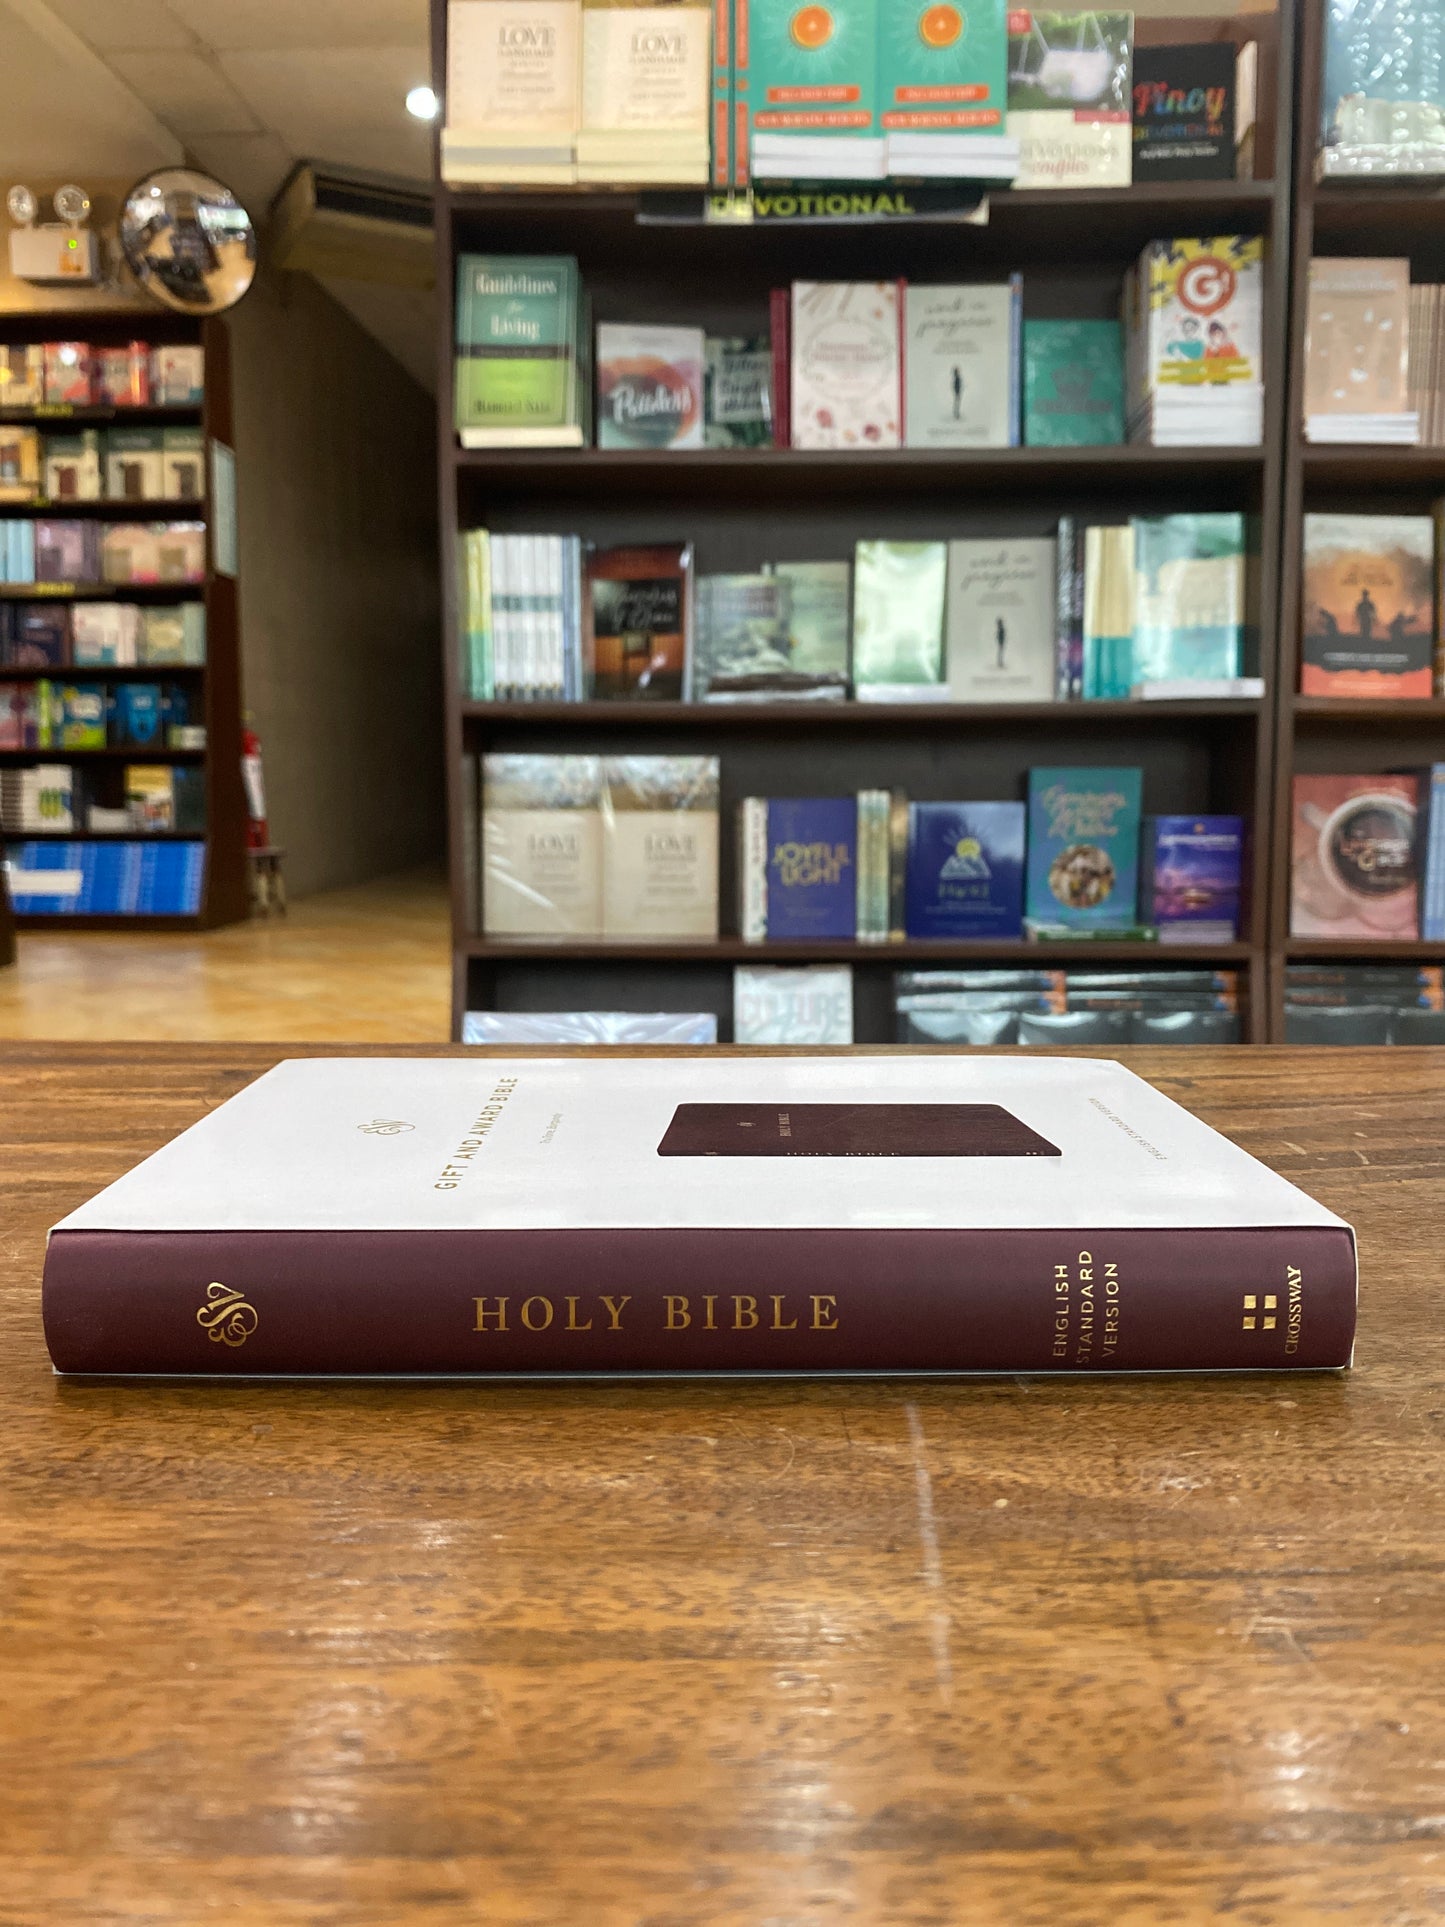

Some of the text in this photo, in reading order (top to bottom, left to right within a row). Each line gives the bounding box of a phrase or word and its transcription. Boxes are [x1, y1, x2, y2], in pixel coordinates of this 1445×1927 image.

[499, 27, 555, 47] LOVE
[630, 34, 687, 54] LOVE
[491, 315, 541, 341] Living
[434, 1077, 518, 1190] GIFT AND AWARD BIBLE
[471, 1294, 839, 1331] HOLY BIBLE
[1052, 1264, 1069, 1357] ENGLISH
[1075, 1250, 1094, 1364] STANDARD
[1101, 1262, 1119, 1358] VERSION
[1284, 1264, 1302, 1354] CROSSWAY
